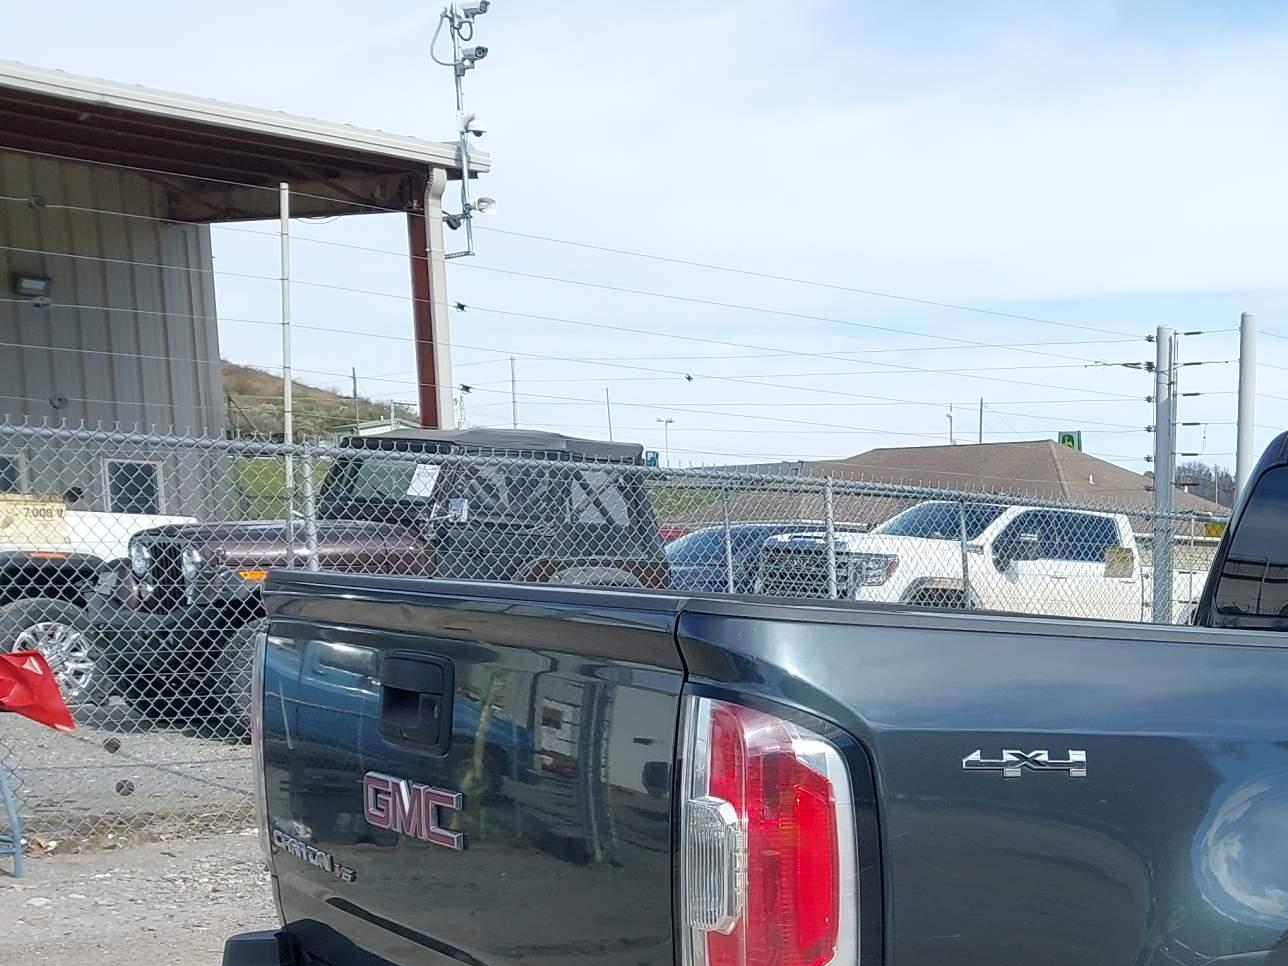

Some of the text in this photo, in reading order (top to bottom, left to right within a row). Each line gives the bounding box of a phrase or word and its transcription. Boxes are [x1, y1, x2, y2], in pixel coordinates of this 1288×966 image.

[363, 771, 464, 850] GMC
[272, 828, 358, 883] CANYON V6
